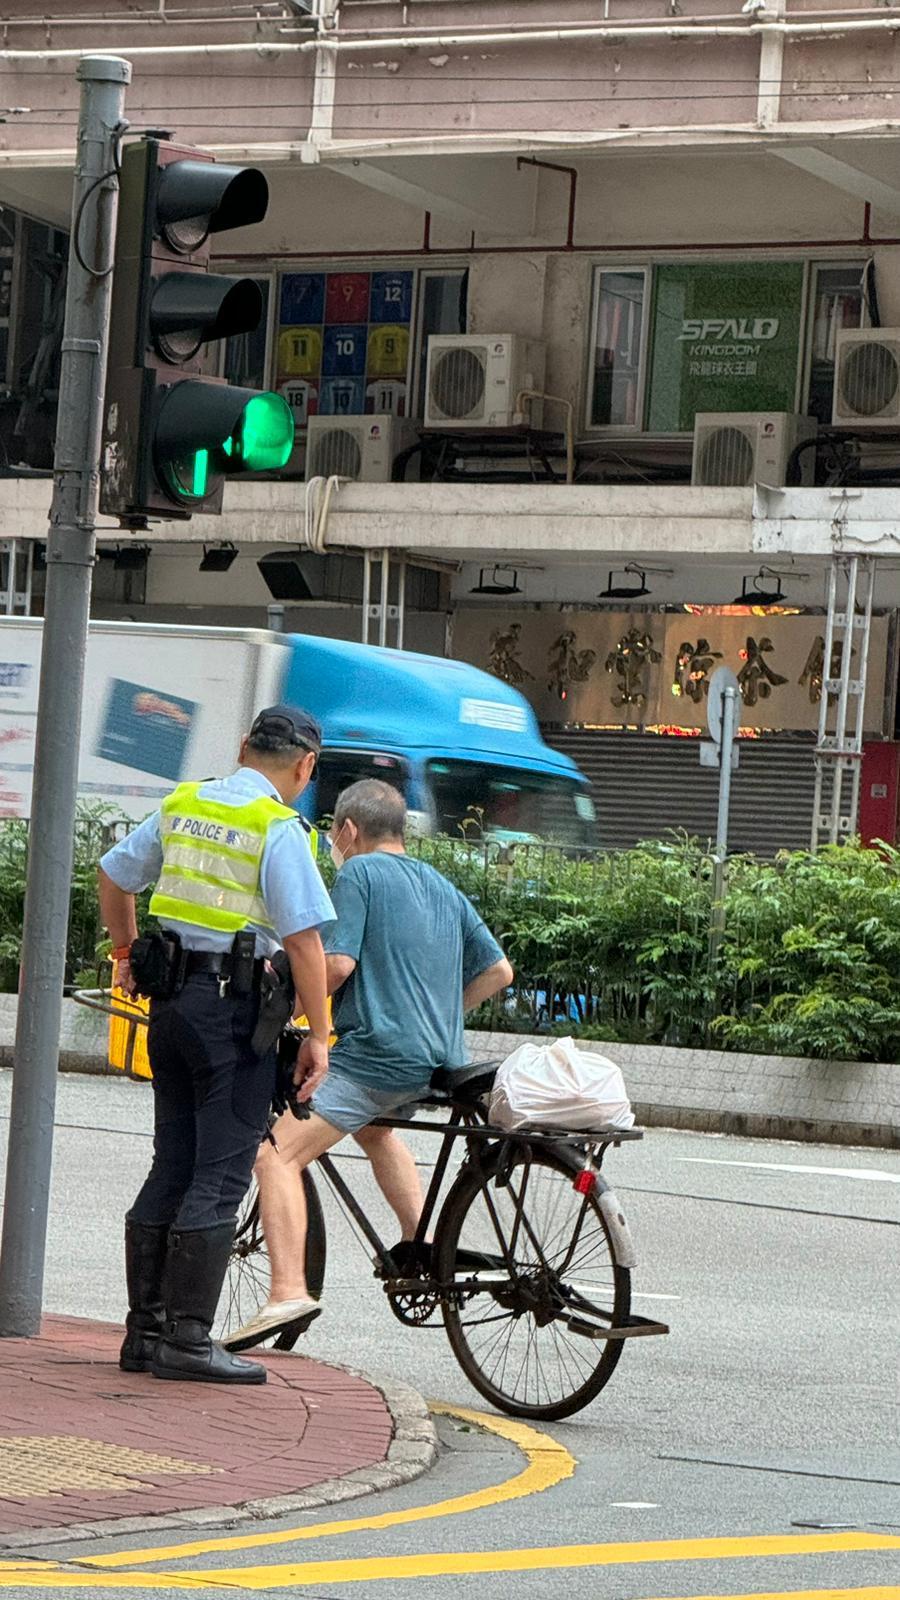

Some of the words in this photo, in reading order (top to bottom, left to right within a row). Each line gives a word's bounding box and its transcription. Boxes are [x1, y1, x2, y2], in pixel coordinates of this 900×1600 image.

[343, 286, 353, 302] 9
[385, 287, 401, 302] 12
[293, 340, 306, 356] 11
[335, 339, 355, 356] 10
[385, 338, 394, 353] 9
[689, 344, 761, 356] KINGDOM
[288, 392, 304, 407] 18
[334, 392, 351, 413] 10
[380, 390, 393, 410] 11
[182, 819, 223, 840] POLICE
